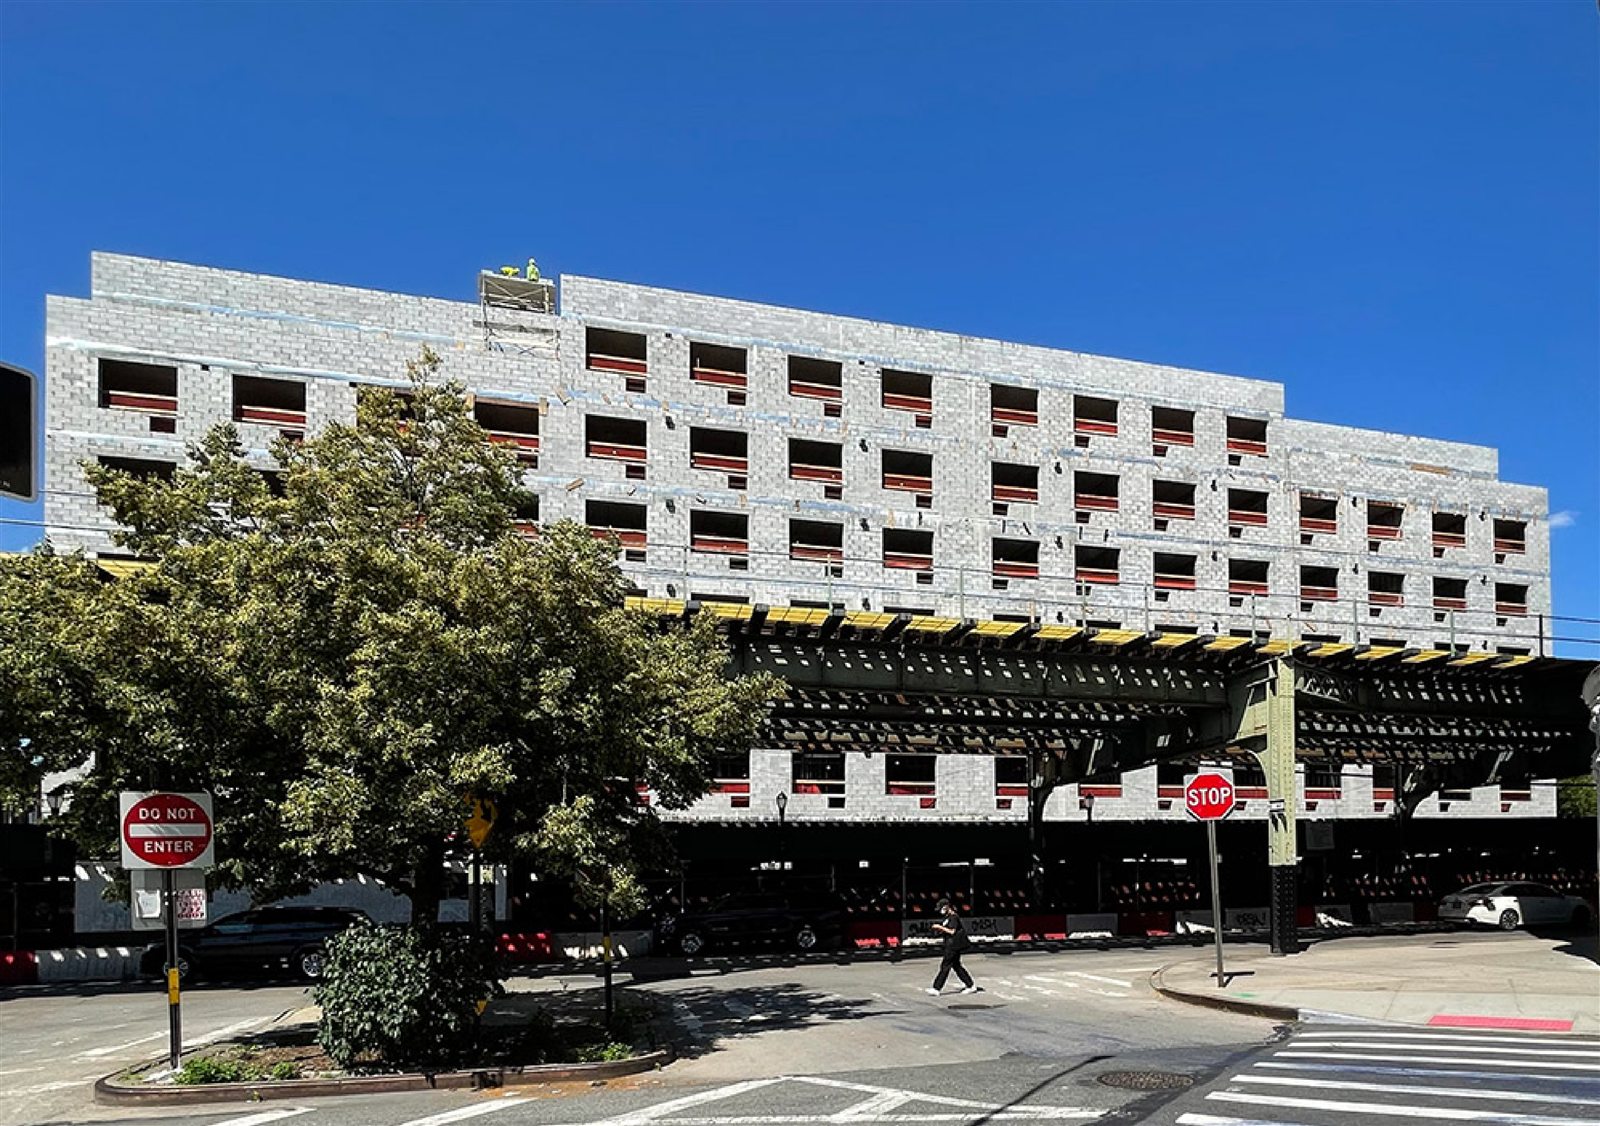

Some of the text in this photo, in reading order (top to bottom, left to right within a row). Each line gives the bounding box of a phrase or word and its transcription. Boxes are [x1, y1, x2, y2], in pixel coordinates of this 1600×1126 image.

[1188, 787, 1231, 806] STOP
[139, 808, 196, 820] DO NOT
[144, 841, 194, 853] ENTER
